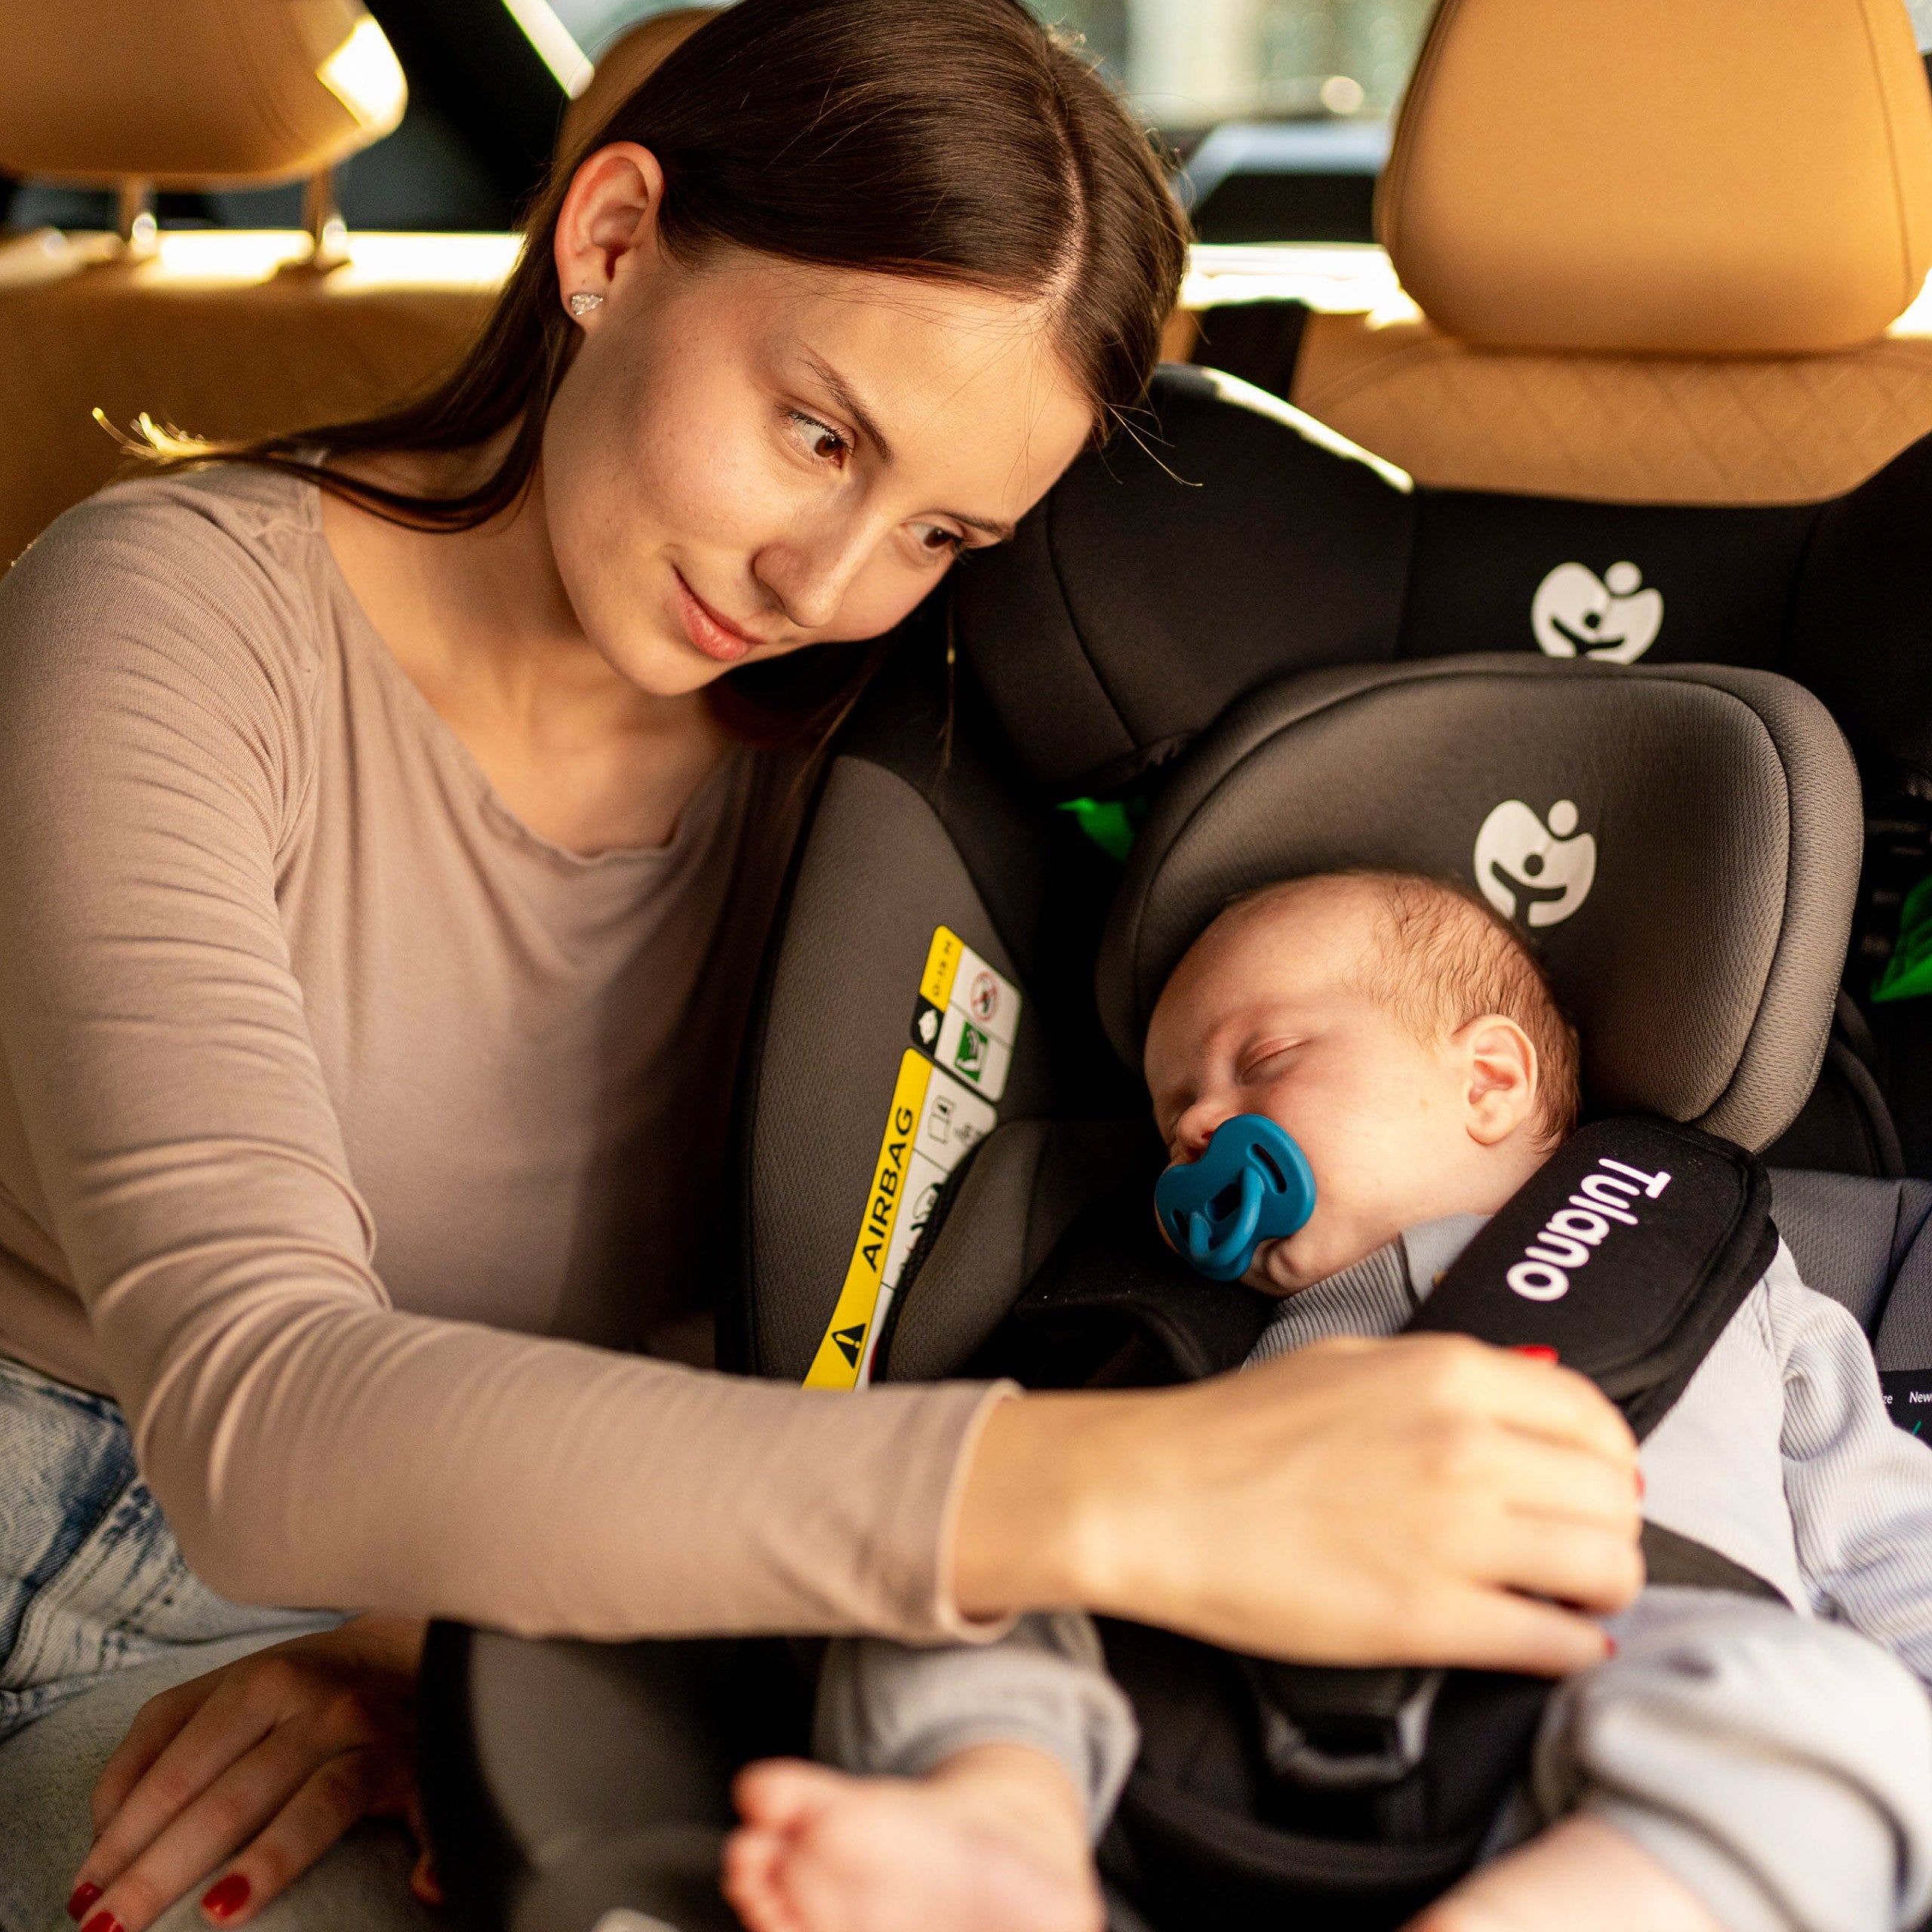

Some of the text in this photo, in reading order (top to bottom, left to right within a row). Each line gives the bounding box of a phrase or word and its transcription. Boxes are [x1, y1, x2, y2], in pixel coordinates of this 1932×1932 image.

[862, 1106, 913, 1273] AIRBAG
[1506, 1158, 1672, 1302] Tulano
[1909, 1391, 1932, 1404] New
